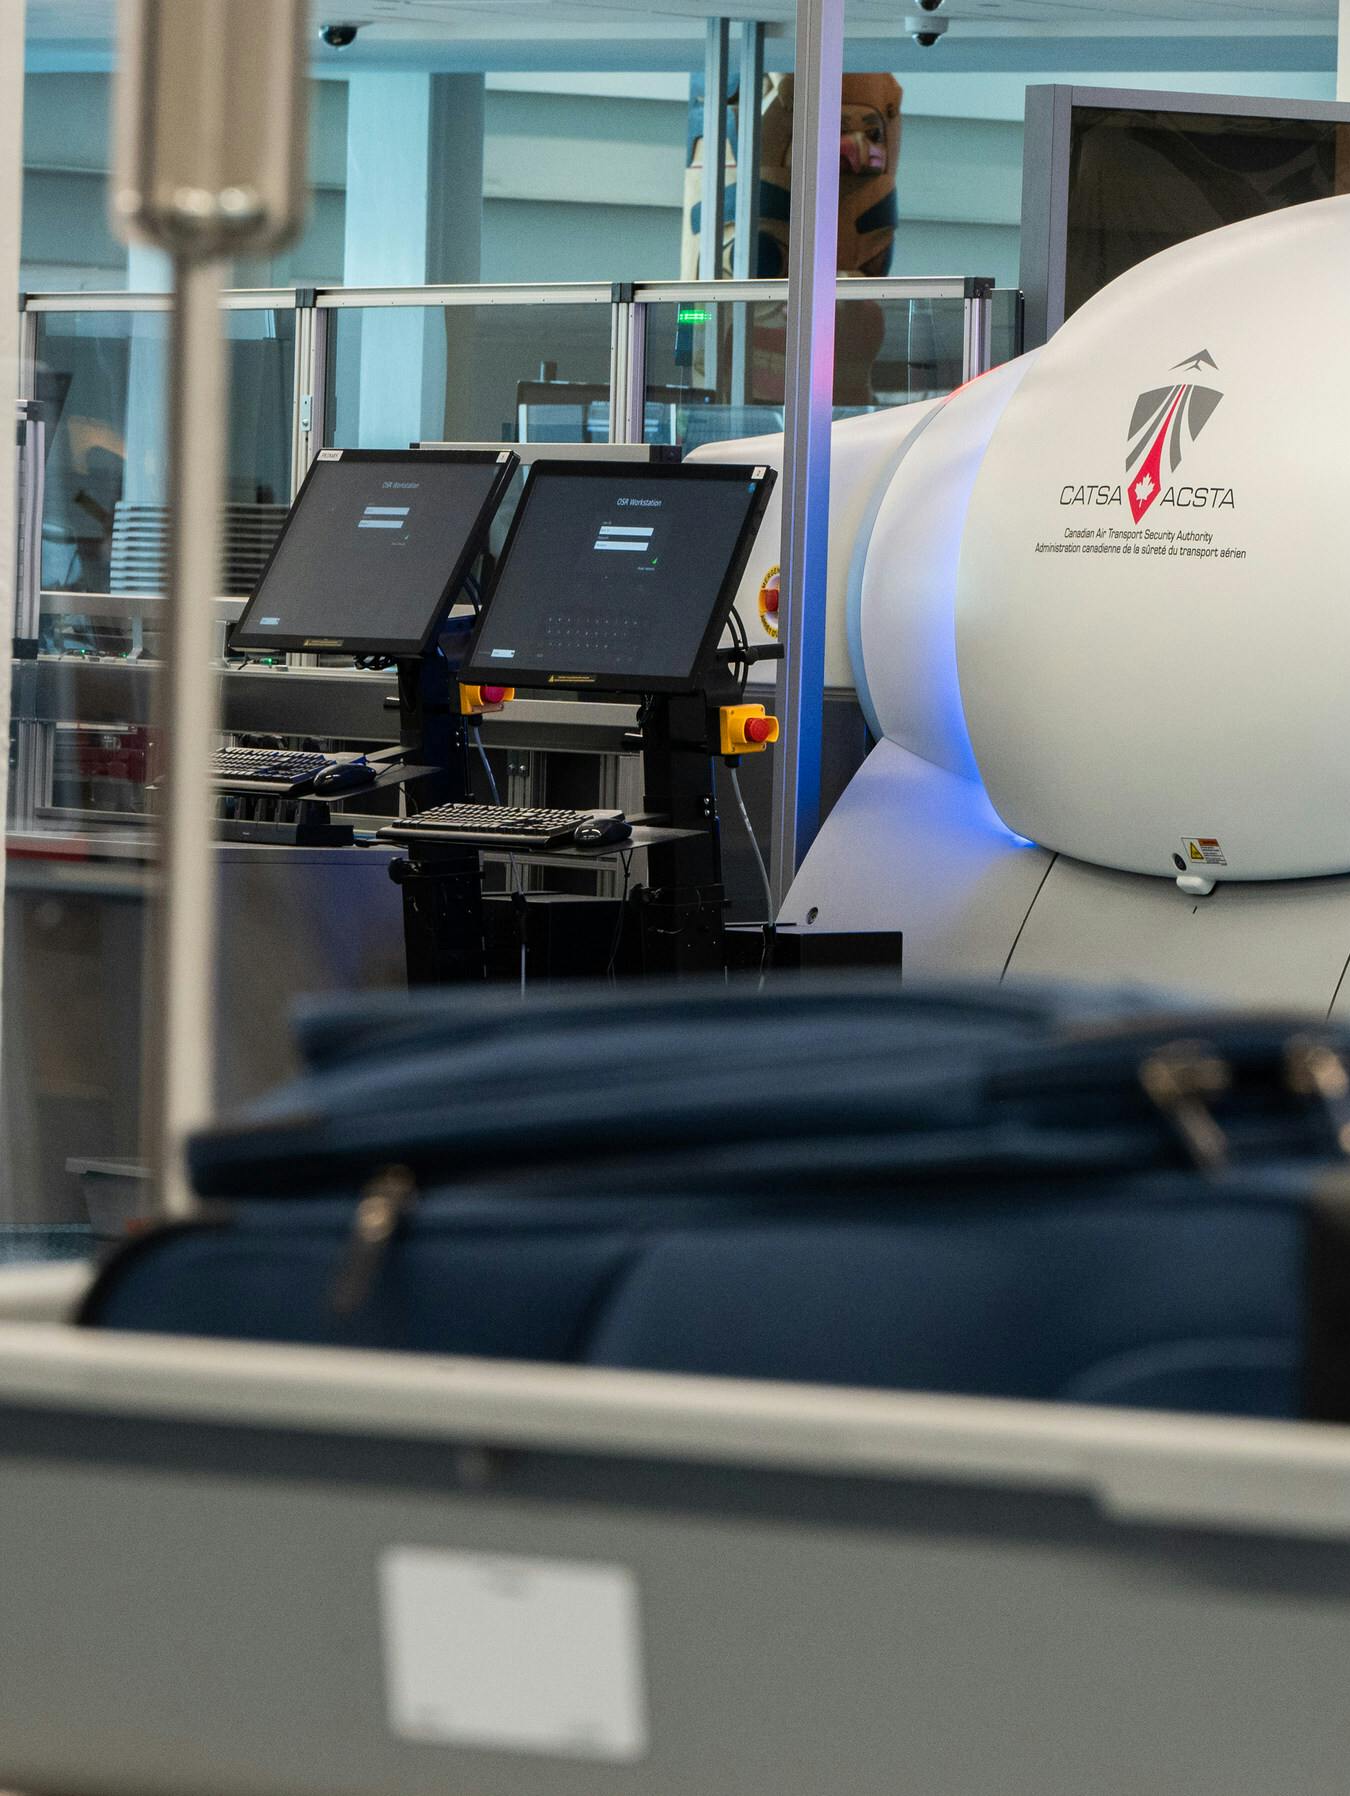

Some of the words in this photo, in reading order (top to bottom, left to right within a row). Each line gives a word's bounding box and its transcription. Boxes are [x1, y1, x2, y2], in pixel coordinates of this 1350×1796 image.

[629, 498, 662, 507] Workstation
[1059, 485, 1122, 506] CATSA
[1159, 486, 1235, 509] ACSTA
[1064, 527, 1095, 539] Canadian
[1095, 528, 1107, 539] Air
[1108, 528, 1143, 541] Transport
[1144, 528, 1176, 543] Security
[1176, 530, 1213, 544] Authority
[1035, 542, 1081, 553] Administration
[1081, 543, 1121, 554] canadienne
[1122, 543, 1131, 554] de
[1132, 544, 1140, 554] la
[1141, 544, 1167, 556] sûreté
[1168, 545, 1178, 556] du
[1179, 547, 1219, 559] transport
[1219, 548, 1247, 559] aérien
